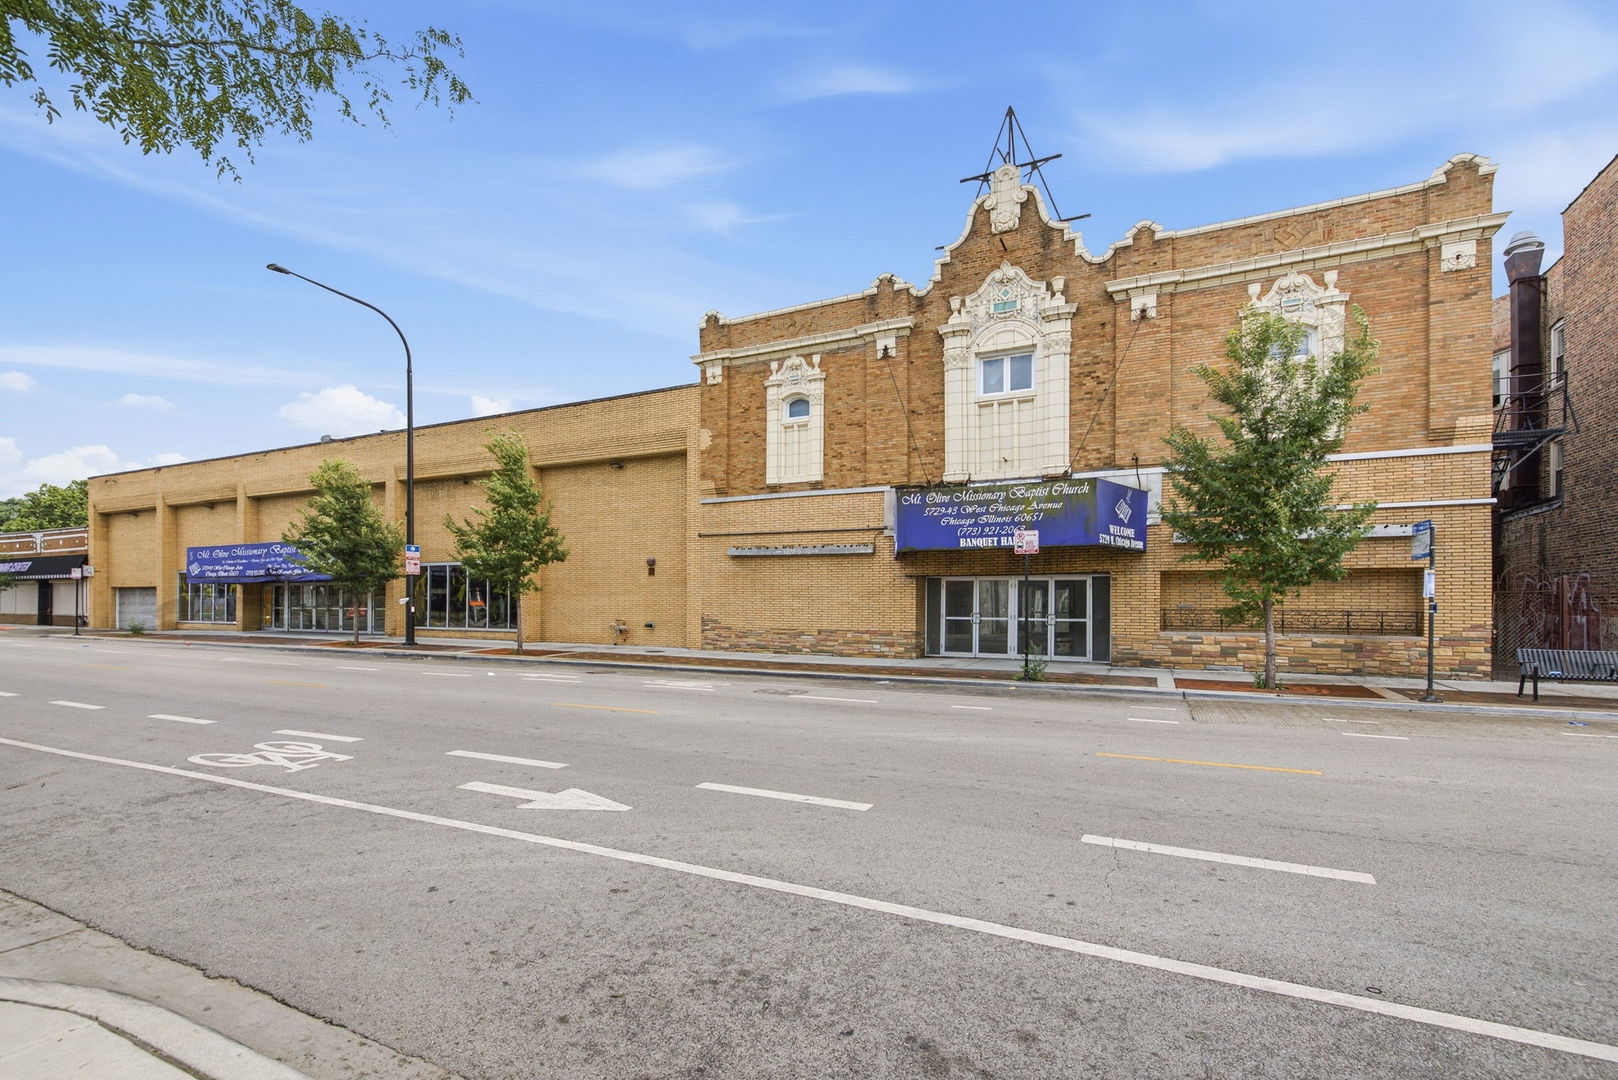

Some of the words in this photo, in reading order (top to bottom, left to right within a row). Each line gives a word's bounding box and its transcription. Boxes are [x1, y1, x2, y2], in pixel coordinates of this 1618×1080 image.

[926, 492, 950, 504] Olive
[953, 490, 1006, 502] Missionary
[1009, 486, 1050, 499] Baptist
[1052, 482, 1089, 495] Church
[924, 506, 958, 516] 5729-43
[960, 504, 986, 514] West
[989, 503, 1024, 514] Chicago
[1027, 501, 1063, 510] Avenue
[941, 516, 975, 527] Chicago
[977, 514, 1012, 524] Illinois
[1014, 512, 1044, 521] 60651
[957, 527, 981, 536] (773)
[1109, 524, 1135, 538] WELCOME
[960, 537, 997, 547] BANQUET
[1000, 536, 1015, 546] HA
